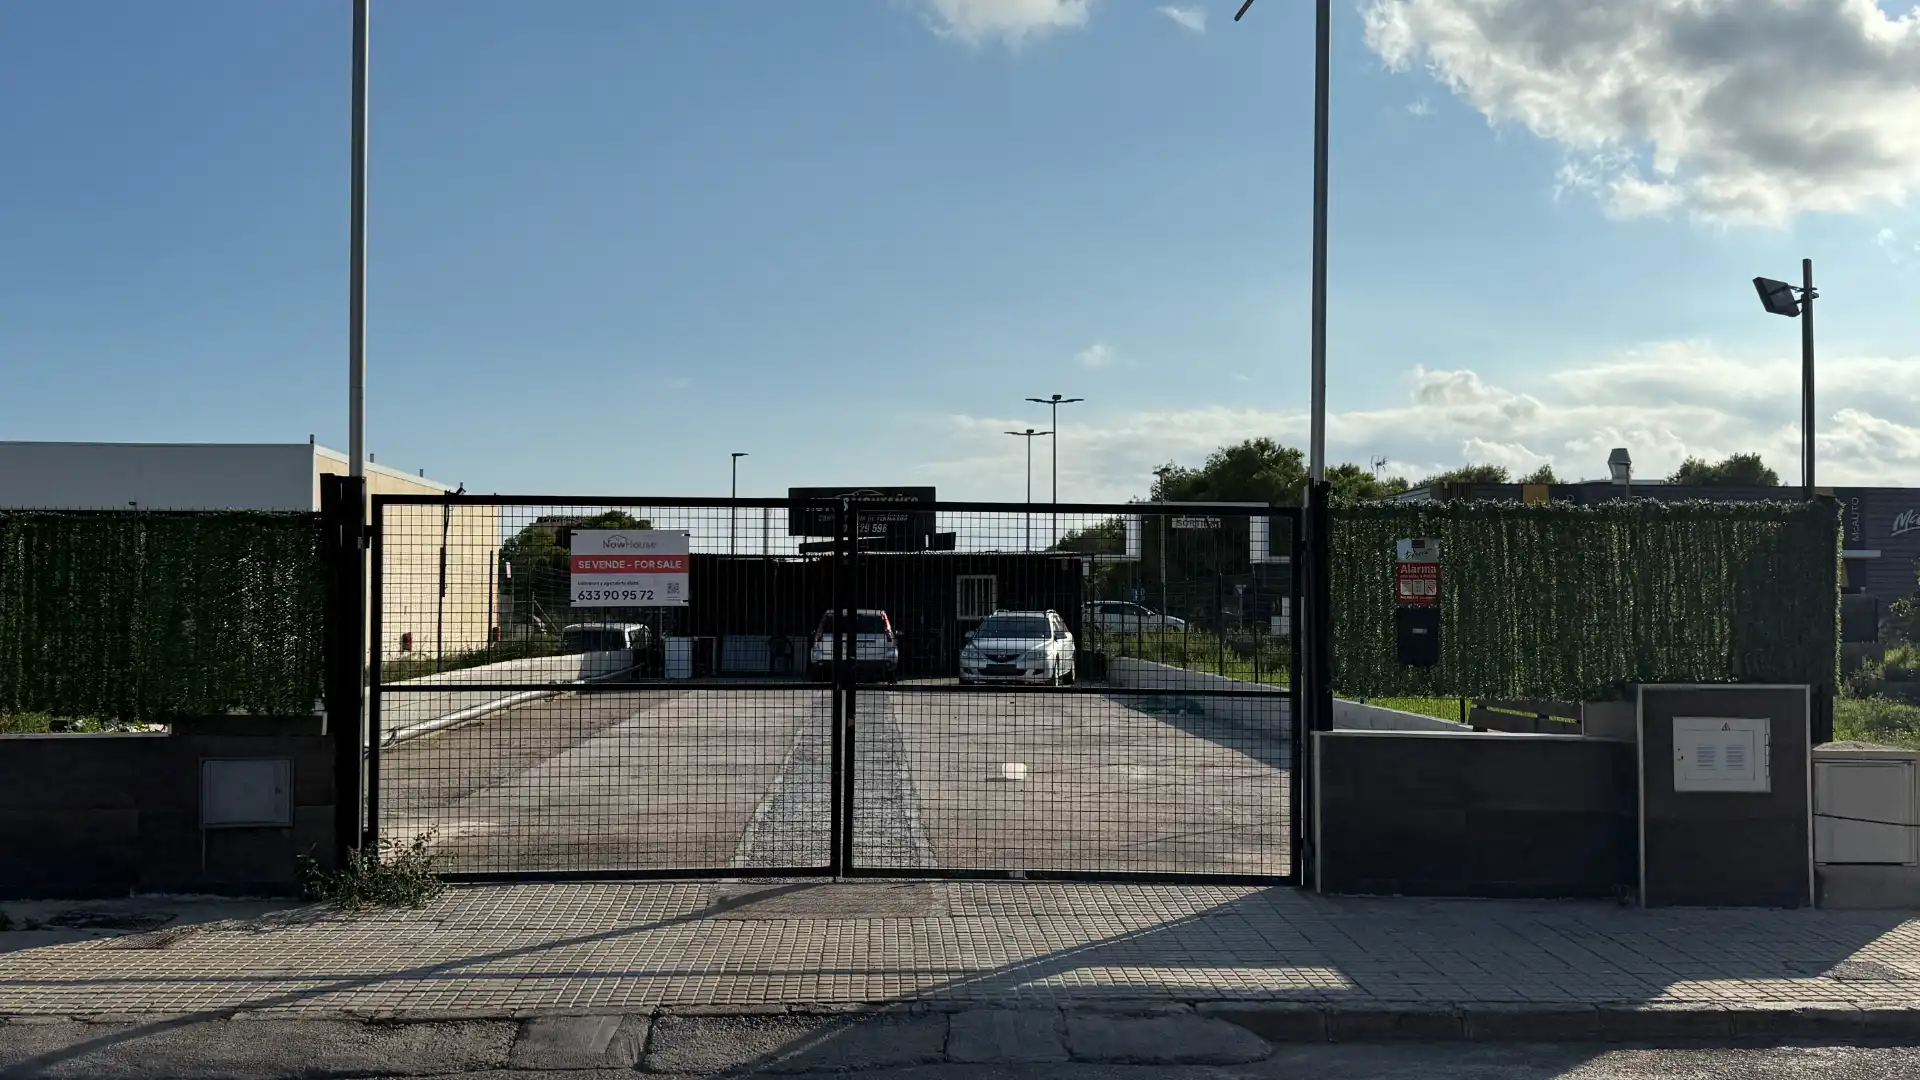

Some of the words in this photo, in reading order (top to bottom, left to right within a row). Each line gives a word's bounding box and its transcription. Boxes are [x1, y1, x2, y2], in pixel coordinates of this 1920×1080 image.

[602, 539, 658, 550] NowHouse
[578, 560, 591, 569] SE
[592, 560, 625, 569] VENDE
[634, 560, 656, 569] FOR
[657, 560, 682, 569] SALE
[1400, 564, 1437, 574] Alarma
[578, 590, 601, 601] 633
[603, 590, 620, 601] 90
[622, 590, 637, 601] 95
[640, 590, 655, 601] 72
